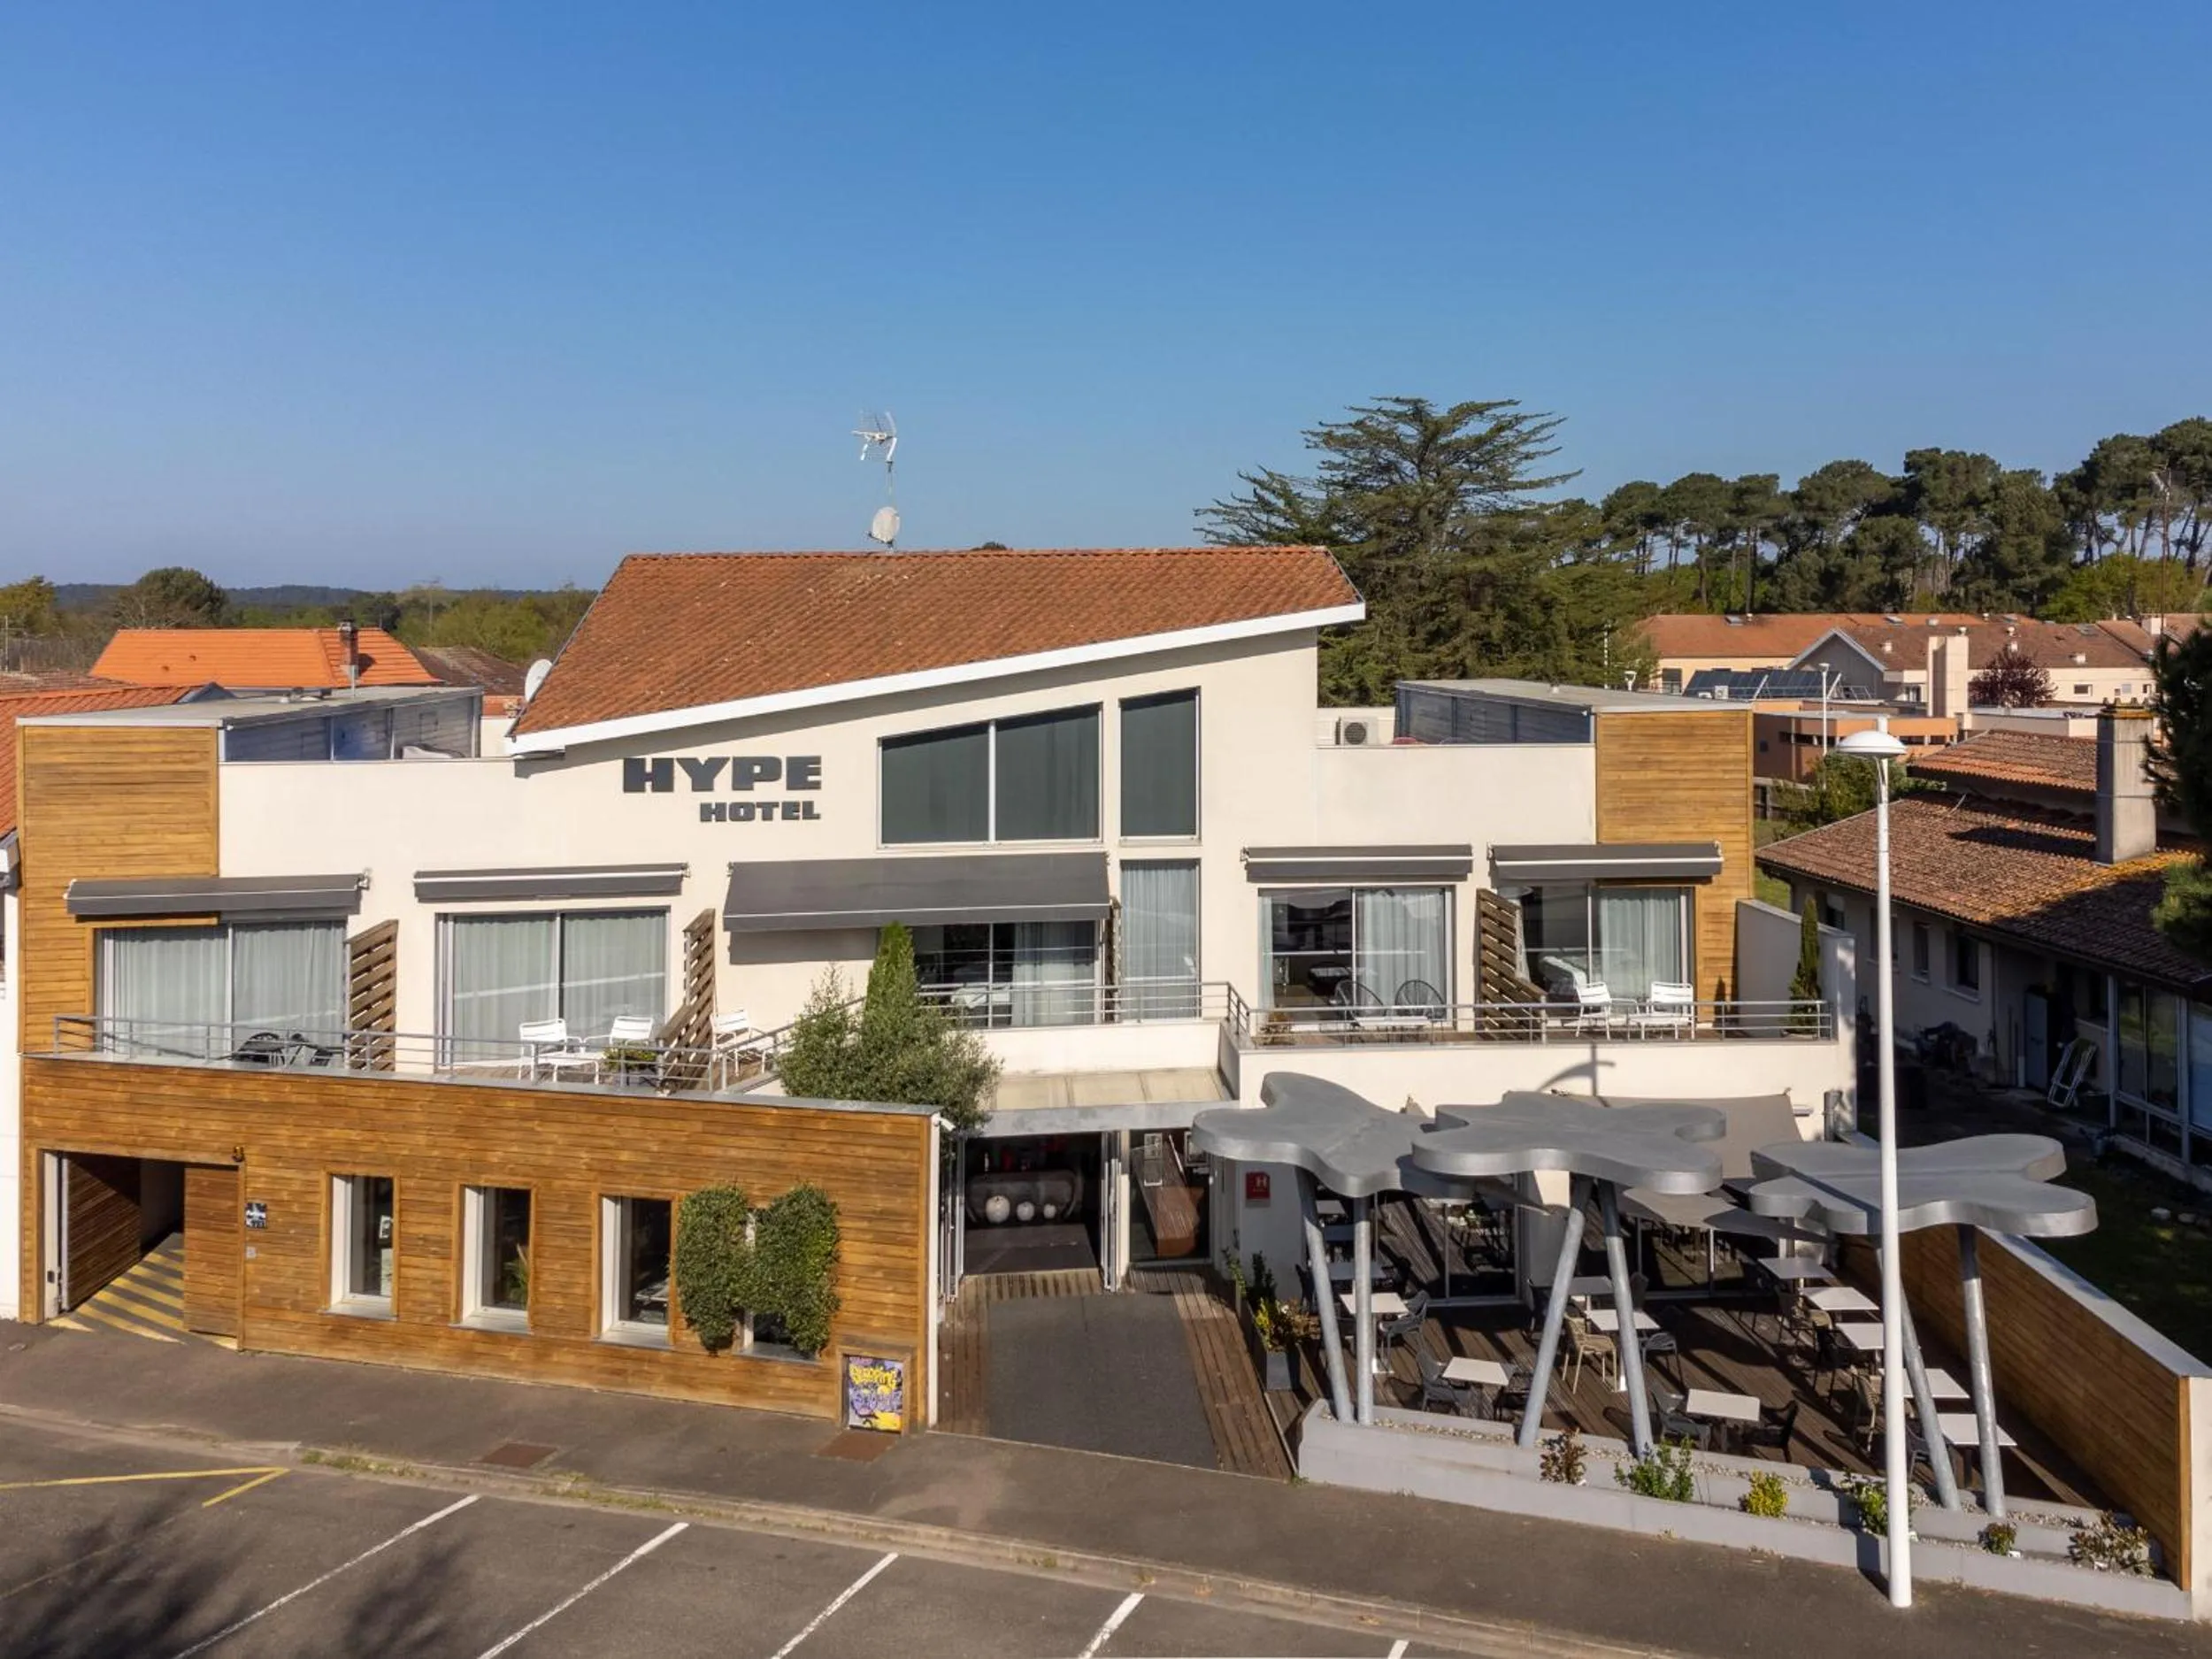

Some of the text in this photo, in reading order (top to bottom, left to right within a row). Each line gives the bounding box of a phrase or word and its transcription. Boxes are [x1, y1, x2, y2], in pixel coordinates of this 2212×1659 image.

[623, 756, 822, 793] HYPE
[700, 800, 821, 823] HOTEL
[1256, 1176, 1267, 1187] H
